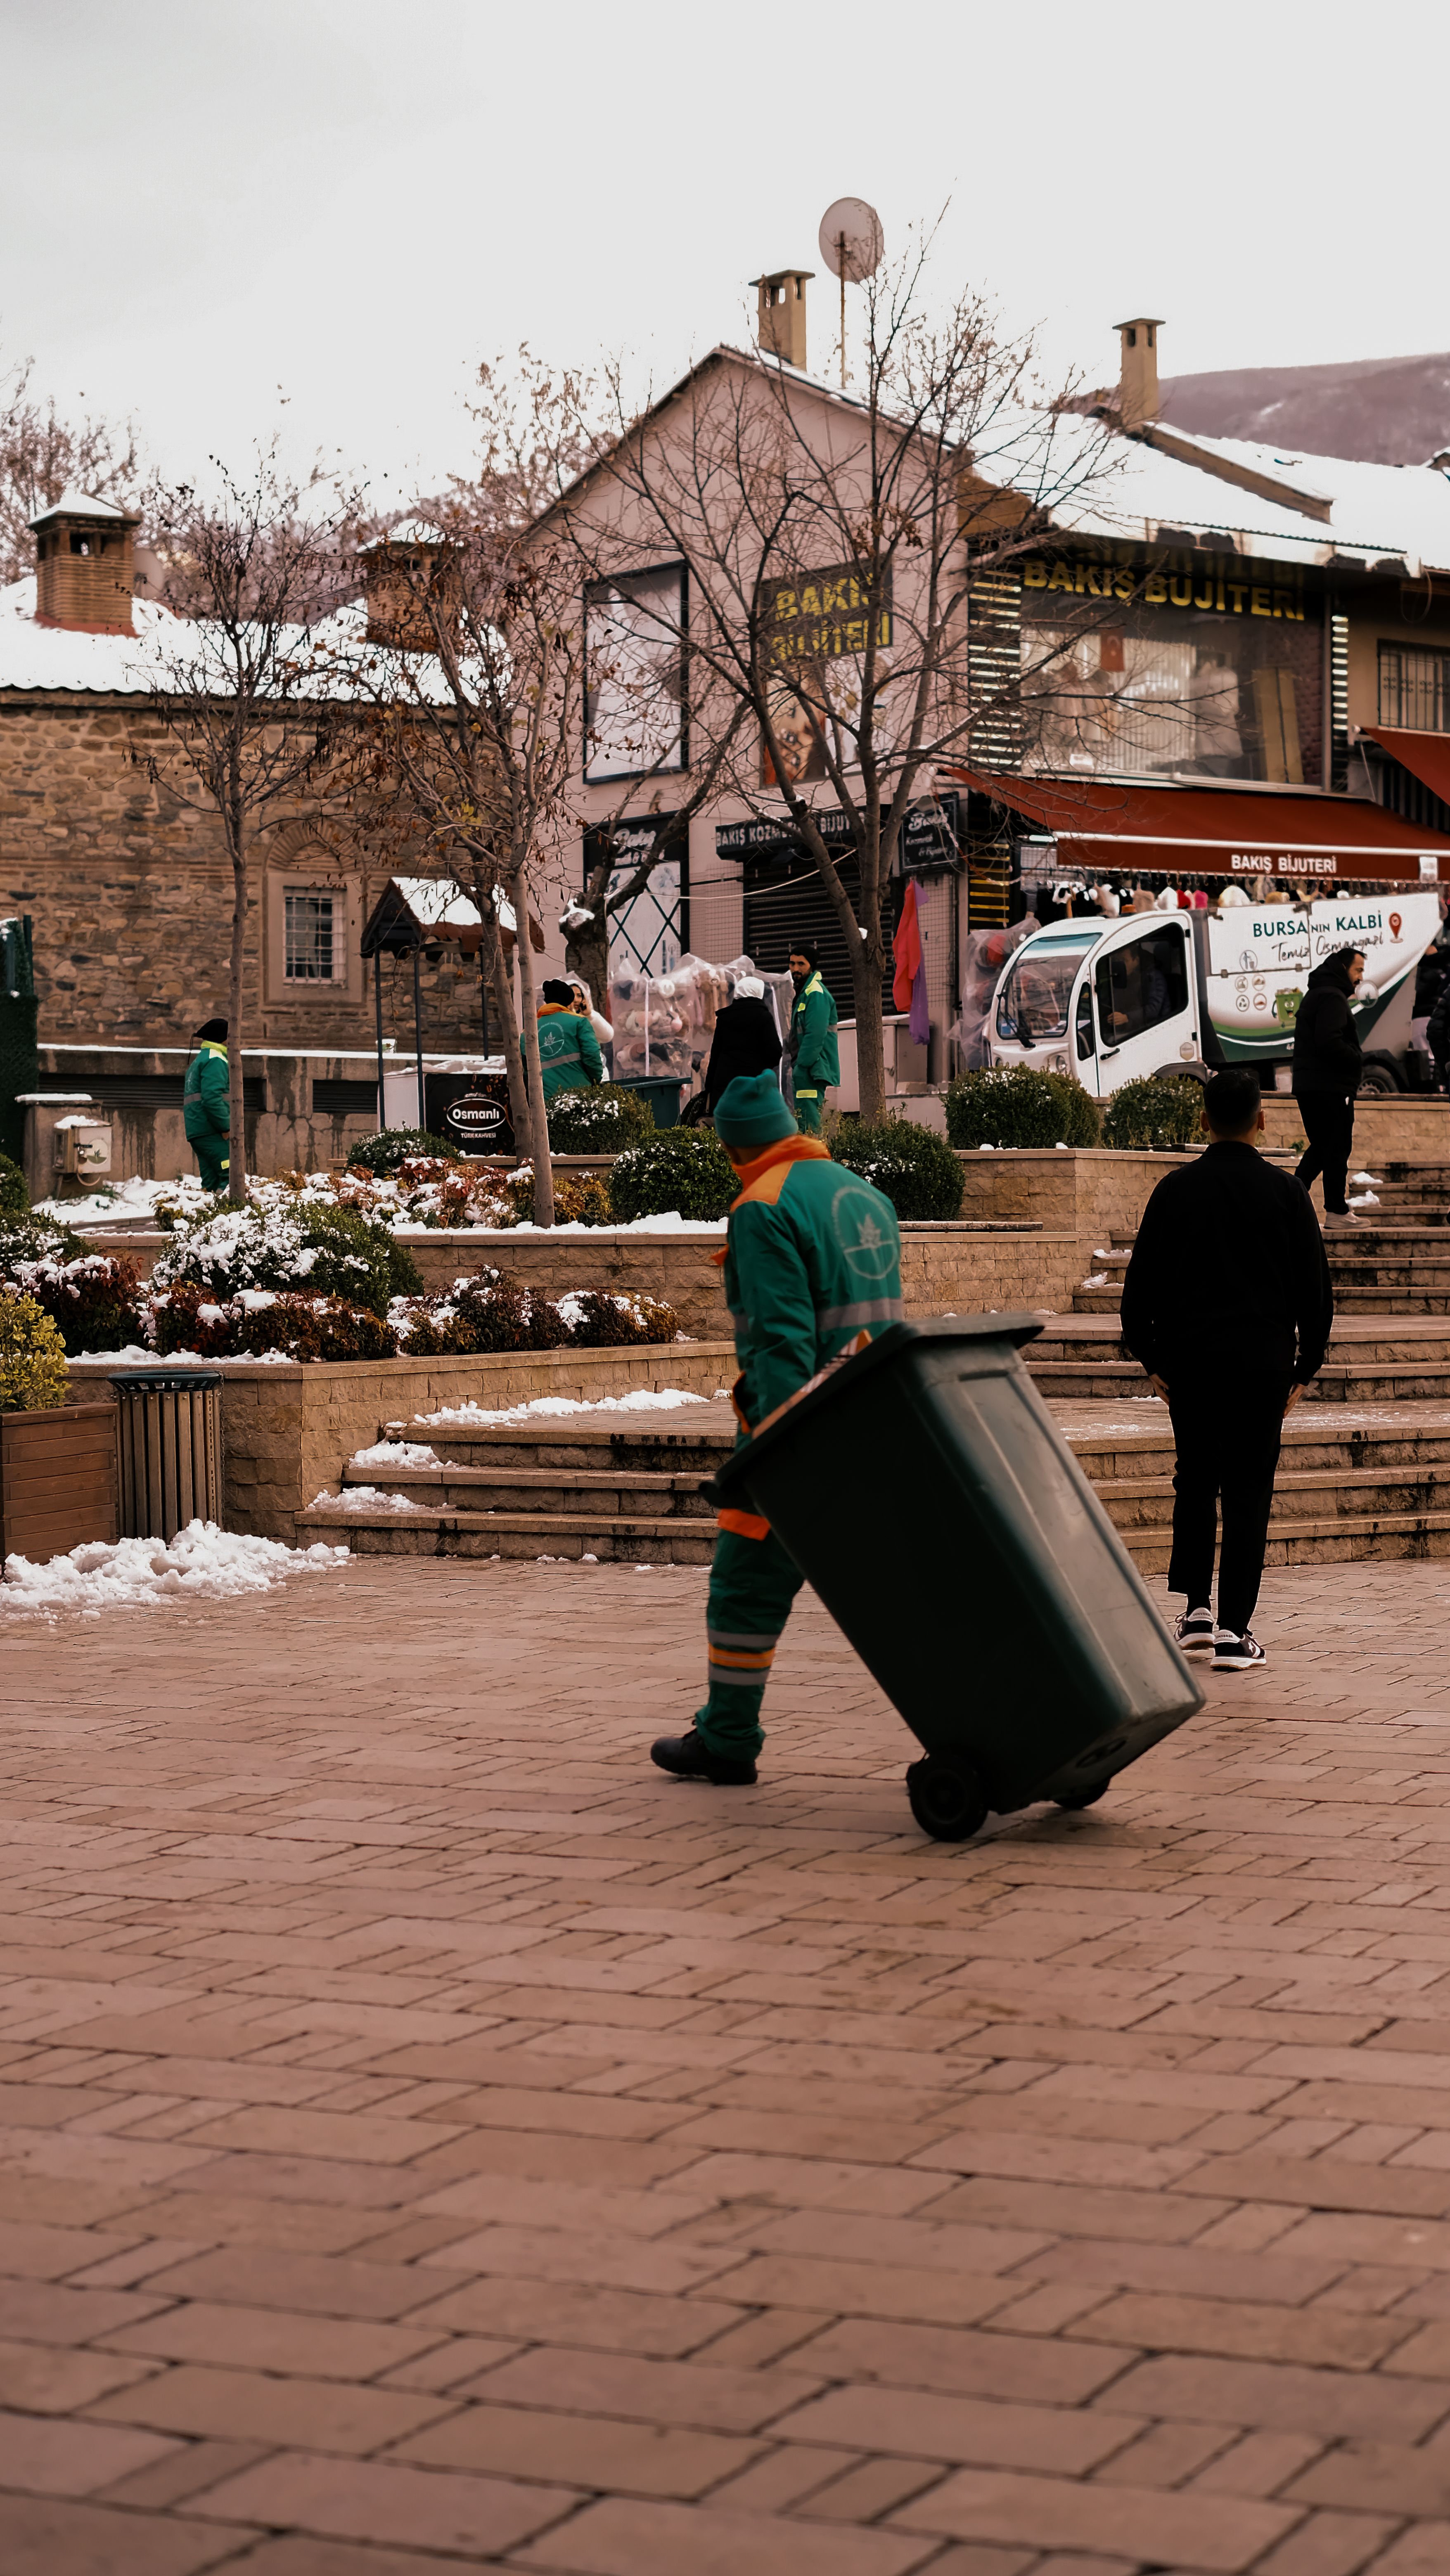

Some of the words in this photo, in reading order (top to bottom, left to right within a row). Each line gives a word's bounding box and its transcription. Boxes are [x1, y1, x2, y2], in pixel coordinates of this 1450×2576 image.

[1231, 854, 1272, 874] BAKIŞ
[1278, 853, 1337, 873] BİJUTERİ
[1336, 909, 1382, 931] KALBİ
[453, 1108, 499, 1120] Osmanlı
